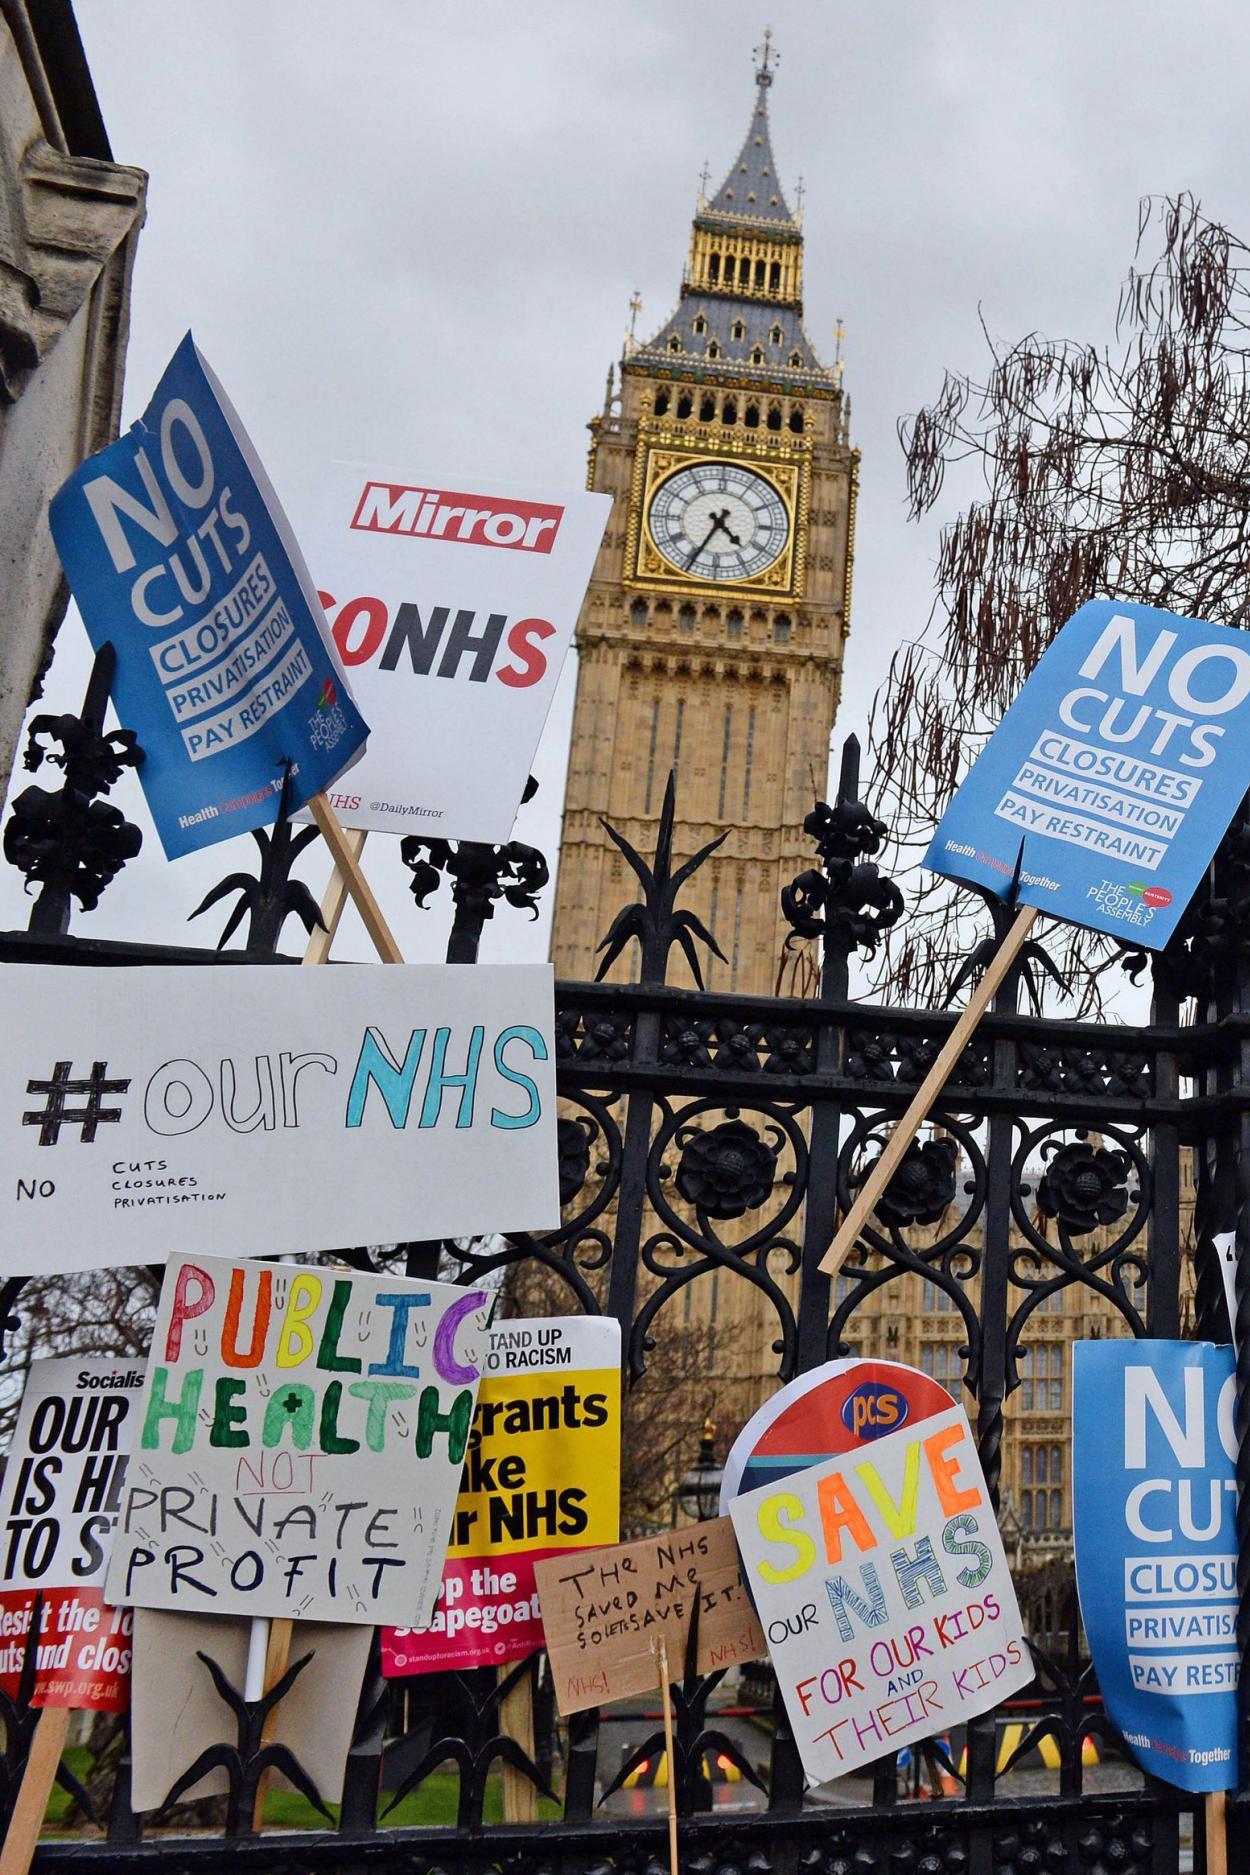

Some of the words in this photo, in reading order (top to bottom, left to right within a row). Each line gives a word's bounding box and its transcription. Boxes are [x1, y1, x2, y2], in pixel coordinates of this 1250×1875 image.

[83, 398, 215, 575] NO
[356, 484, 558, 549] Mirror
[131, 485, 251, 628] CUTS
[158, 562, 272, 673] CLOSURES
[317, 590, 557, 688] ONHS
[172, 613, 290, 715] PRIVATISATION
[187, 716, 235, 755] PAY
[239, 652, 309, 731] RESTRAINT
[1058, 687, 1227, 768] CUTS
[1039, 737, 1193, 802] CLOSURES
[178, 804, 220, 830] Health
[369, 801, 444, 818] @DailyMirror
[1018, 770, 1179, 833] PRIVATISATION
[1000, 797, 1045, 826] PAY
[1045, 816, 1164, 863] RESTRAINT
[944, 839, 977, 859] Health
[1018, 869, 1061, 893] Together
[1100, 878, 1127, 897] THE
[1095, 902, 1152, 928] ASSEMBLY
[16, 1178, 56, 1201] NO
[111, 1176, 199, 1191] CLOSURES
[112, 1160, 168, 1175] CUTS
[113, 1191, 227, 1210] PRIVATISATION
[164, 1263, 490, 1386] PUBLIC
[538, 1328, 563, 1347] UP
[505, 1347, 572, 1369] RACISM
[29, 1396, 130, 1454] OUR
[140, 1366, 475, 1466] HEALTH
[852, 1393, 900, 1438] pcs
[1124, 1366, 1237, 1470] N
[10, 1456, 62, 1517] IS
[235, 1450, 329, 1494] NOT
[124, 1486, 400, 1551] PRIVATE
[489, 1487, 589, 1545] NHS
[757, 1423, 983, 1585] SAVE
[4, 1517, 60, 1581] TO
[71, 1516, 119, 1578] S
[124, 1545, 406, 1601] PROFIT
[656, 1536, 709, 1569] NHS
[471, 1567, 517, 1597] the
[702, 1571, 745, 1614] IT!
[767, 1603, 820, 1646] OUR
[824, 1513, 994, 1643] NHS
[57, 1599, 101, 1633] the
[394, 1593, 543, 1638] apegoat
[708, 1627, 757, 1666] NHS!
[795, 1657, 866, 1718] FOR
[869, 1624, 933, 1681] OUR
[937, 1593, 1002, 1651] KIDS
[565, 1670, 610, 1699] NHS!
[812, 1679, 945, 1761] THEIR
[951, 1640, 1023, 1701] KIDS
[886, 1668, 925, 1698] AND
[1133, 1664, 1178, 1688] PAY
[1122, 1730, 1151, 1749] Health
[1188, 1748, 1231, 1767] Together
